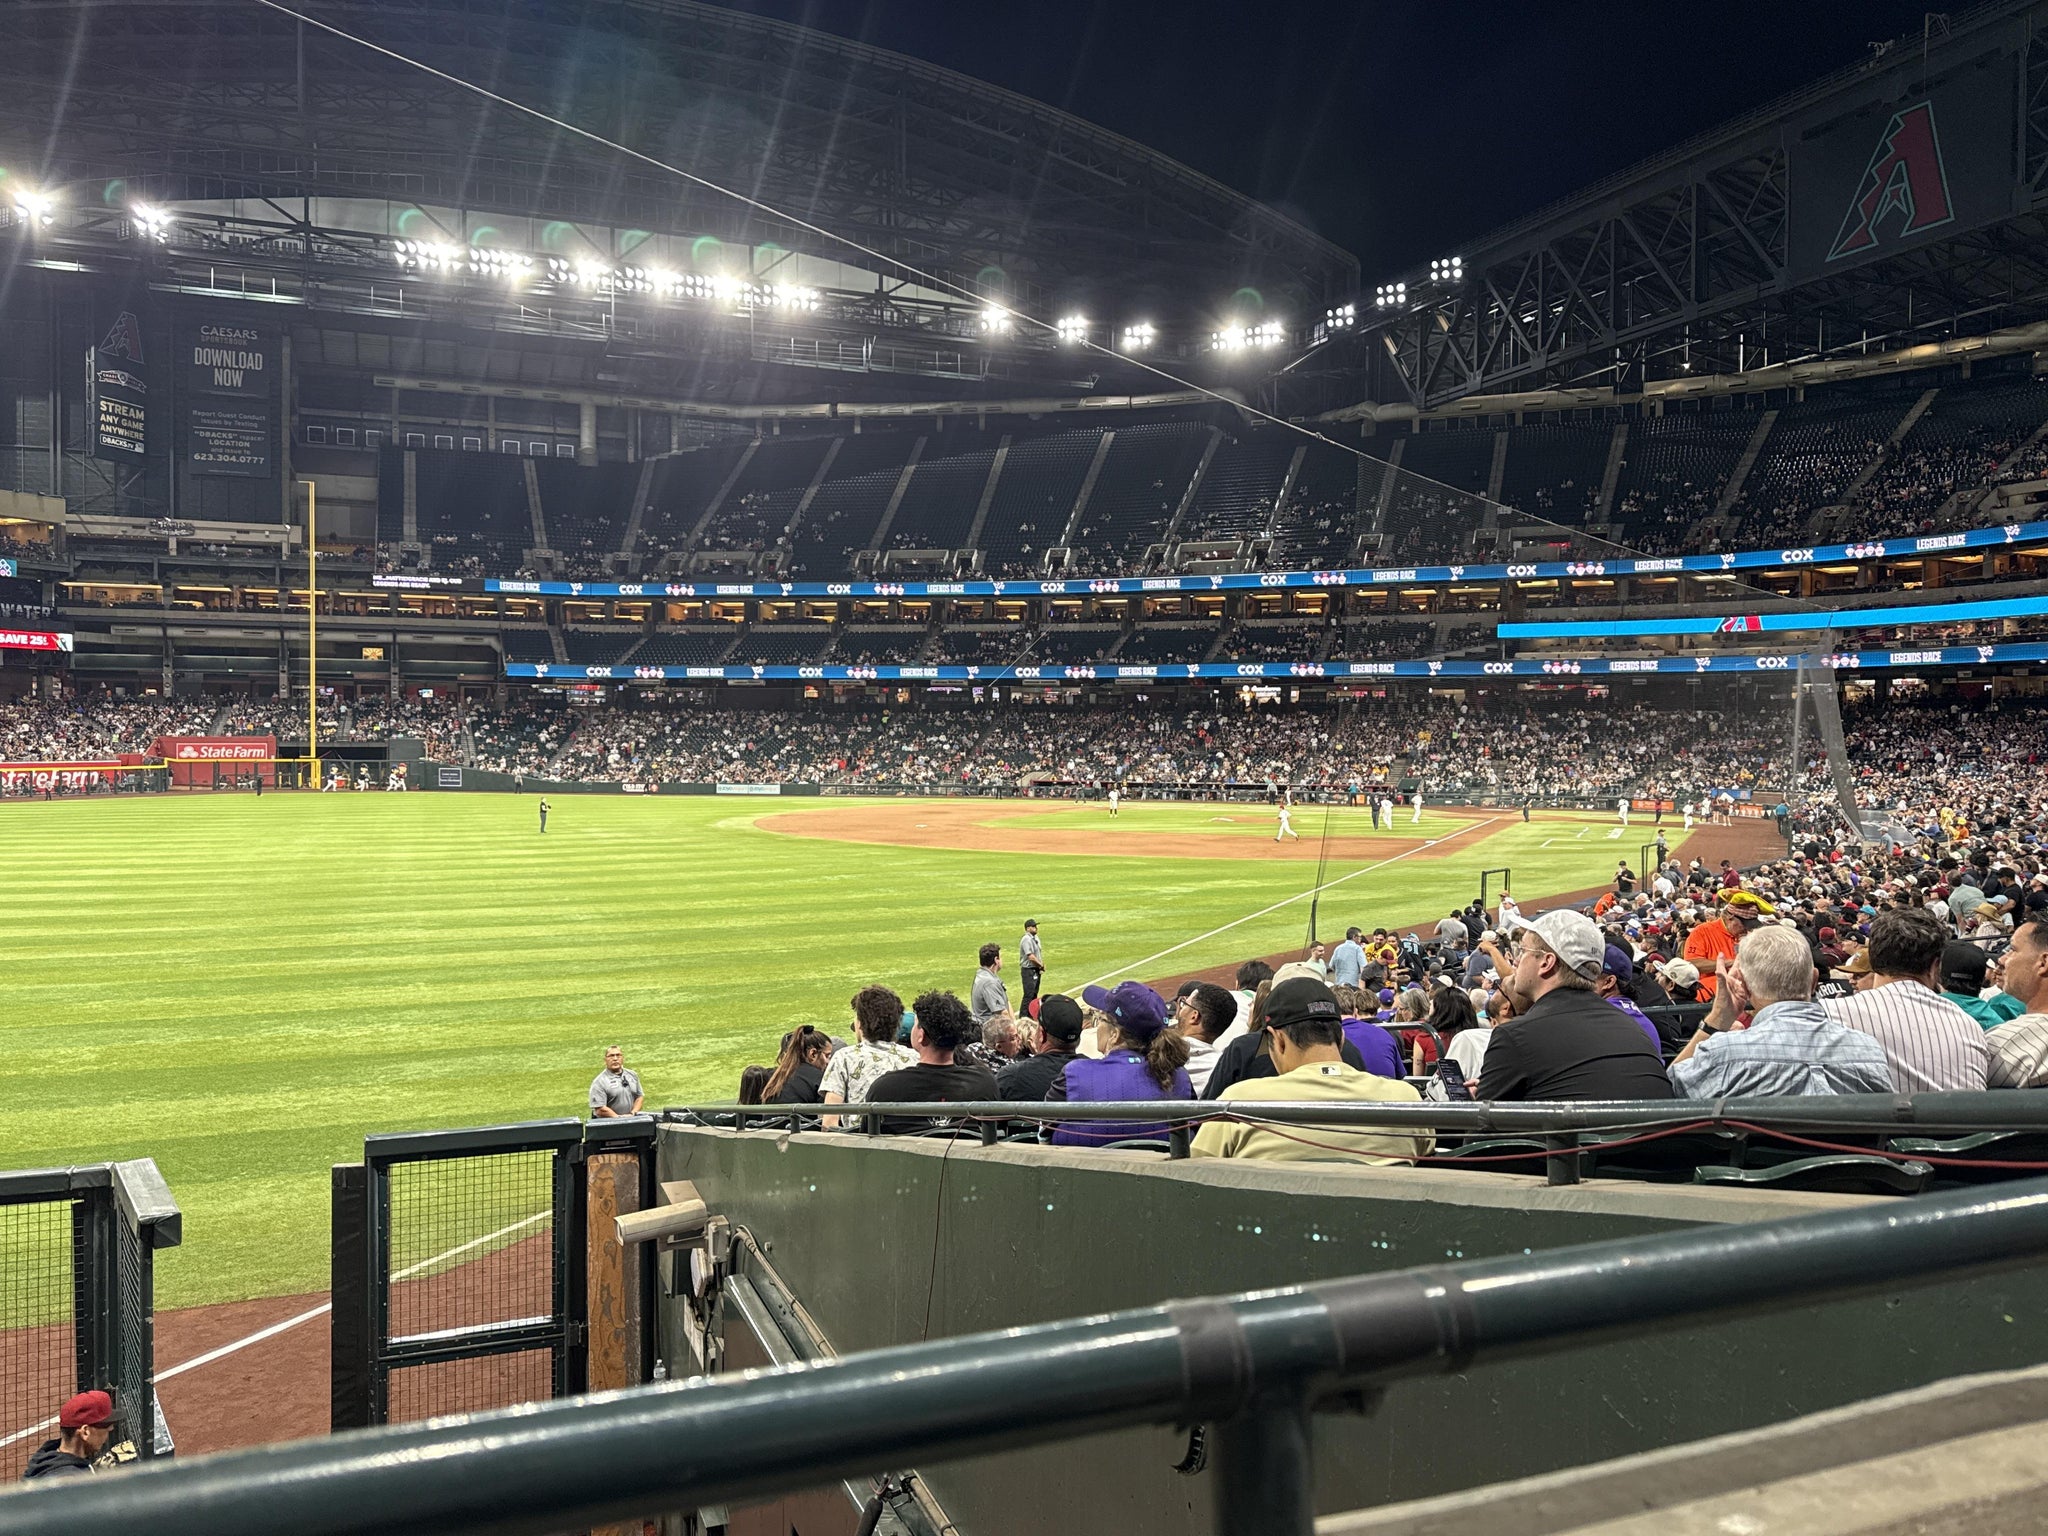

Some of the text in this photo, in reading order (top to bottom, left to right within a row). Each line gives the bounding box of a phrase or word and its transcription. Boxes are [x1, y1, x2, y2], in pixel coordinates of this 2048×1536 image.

[200, 325, 258, 340] CAESARS
[194, 347, 263, 371] DOWNLOAD
[214, 367, 244, 388] NOW
[100, 400, 145, 421] STREAM
[100, 413, 145, 431] ANY GAME
[238, 413, 266, 421] Conduct
[100, 424, 145, 441] ANYWHERE
[208, 439, 250, 448] LOCATION
[193, 452, 265, 464] 623.304.0777
[1917, 534, 1966, 550] LEGENDS RACE
[1782, 549, 1814, 563] COX
[1507, 564, 1537, 577] COX
[1635, 559, 1683, 571] LEGENDS RACE
[1259, 574, 1287, 586] COX
[1372, 569, 1417, 581] LEGENDS RACE
[619, 584, 643, 595] COX
[827, 584, 851, 595] COX
[926, 584, 965, 594] LEGENDS RACE
[1041, 582, 1066, 593] COX
[1142, 578, 1181, 589] LEGENDS RACE
[0, 634, 44, 645] SAVE
[1756, 656, 1788, 669] COX
[1890, 651, 1941, 663] LEGENDS RACE
[799, 667, 823, 677] COX
[1015, 667, 1041, 677] COX
[1119, 667, 1157, 676] LEGENDS RACE
[1238, 664, 1264, 675] COX
[1350, 664, 1395, 673] LEGENDS RACE
[1484, 662, 1513, 674] COX
[1610, 661, 1658, 671] LEGENDS RACE
[585, 667, 611, 678] COX
[1403, 941, 1419, 955] 51
[1687, 946, 1697, 954] 33
